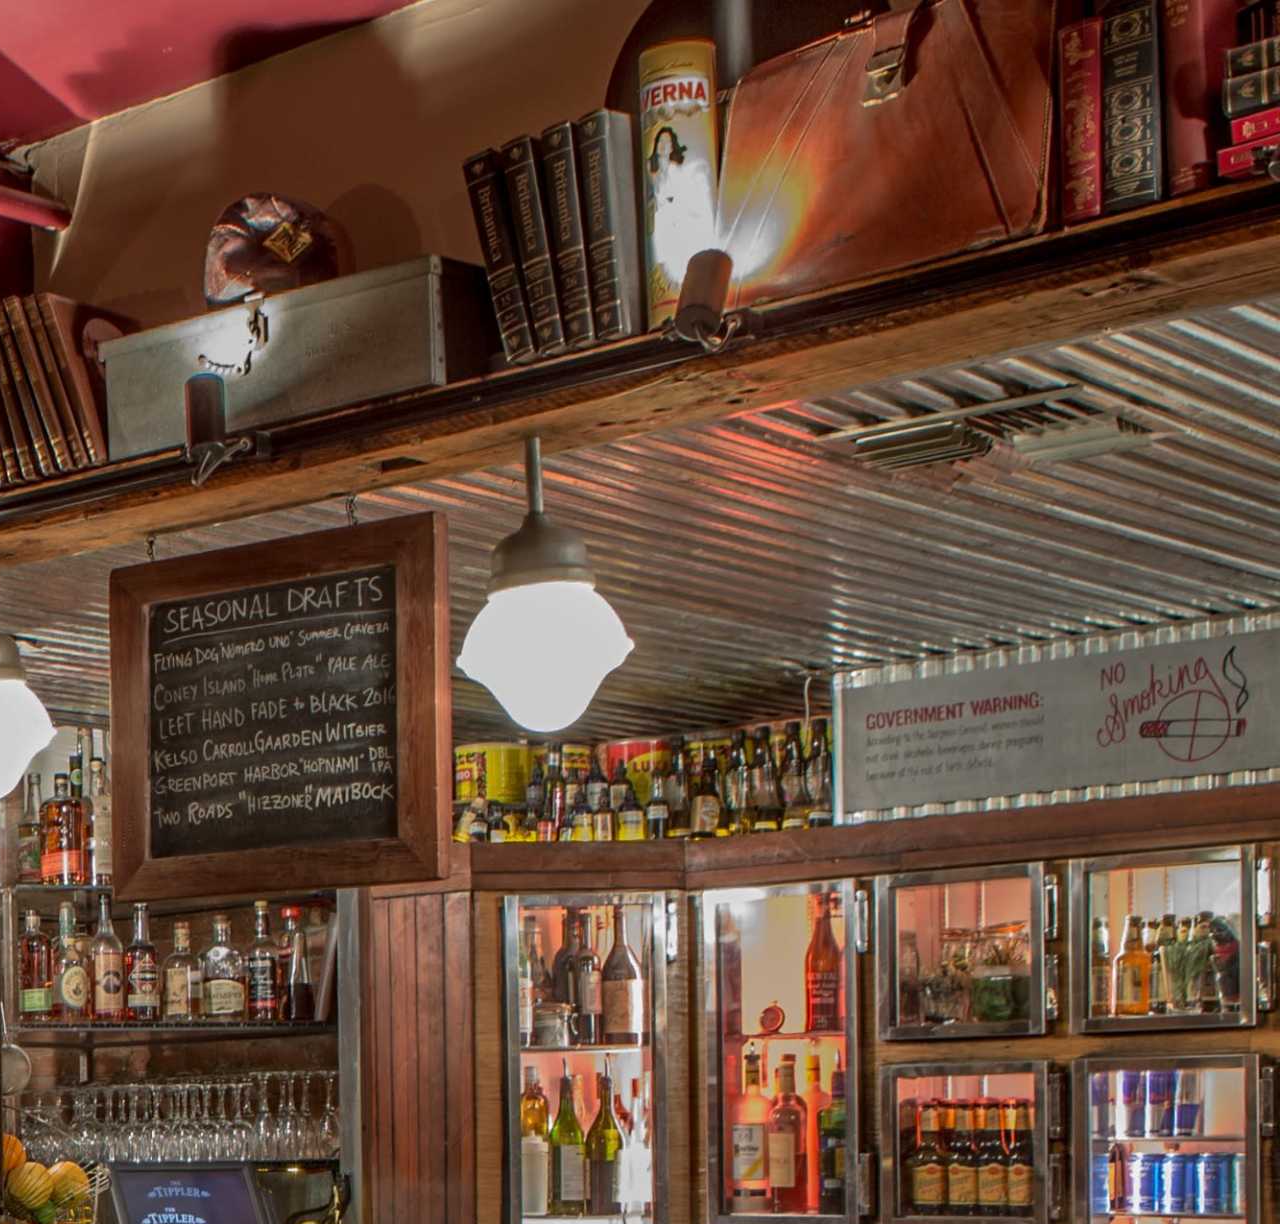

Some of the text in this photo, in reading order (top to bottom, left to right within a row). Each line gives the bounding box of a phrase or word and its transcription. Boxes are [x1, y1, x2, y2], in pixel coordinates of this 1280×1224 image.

[514, 173, 537, 251] Britannica
[552, 158, 571, 240] Britannica
[588, 150, 603, 231] Britannica
[477, 185, 502, 264] Britannica
[164, 576, 383, 633] SEASONAL DRAFTS
[154, 651, 192, 674] FLYING
[195, 647, 220, 665] DOG
[297, 626, 342, 647] SUMMER
[344, 621, 389, 640] CERVEZA
[154, 683, 197, 711] CONEY
[203, 676, 246, 697] ISLAND
[327, 655, 357, 674] PALE
[361, 653, 389, 671] ALE
[1100, 661, 1126, 690] NO
[159, 712, 194, 740] LEFT
[202, 708, 246, 732] HAND
[251, 698, 288, 721] FADE
[310, 691, 358, 714] BLACK
[865, 692, 1044, 730] GOVERNMENT WARNING:
[1097, 656, 1227, 748] Smoking
[154, 749, 198, 772] KELSO
[325, 722, 386, 743] WITBIER
[154, 771, 237, 794] GREENPORT
[244, 762, 301, 783] HARBOR
[369, 746, 393, 762] DBL
[371, 761, 393, 774] IPA
[154, 809, 181, 828] TWO
[188, 801, 234, 825] ROADS
[315, 784, 393, 808] MAIBOCK
[154, 1186, 200, 1198] TIPPLER
[148, 1213, 196, 1224] TIPPLER
